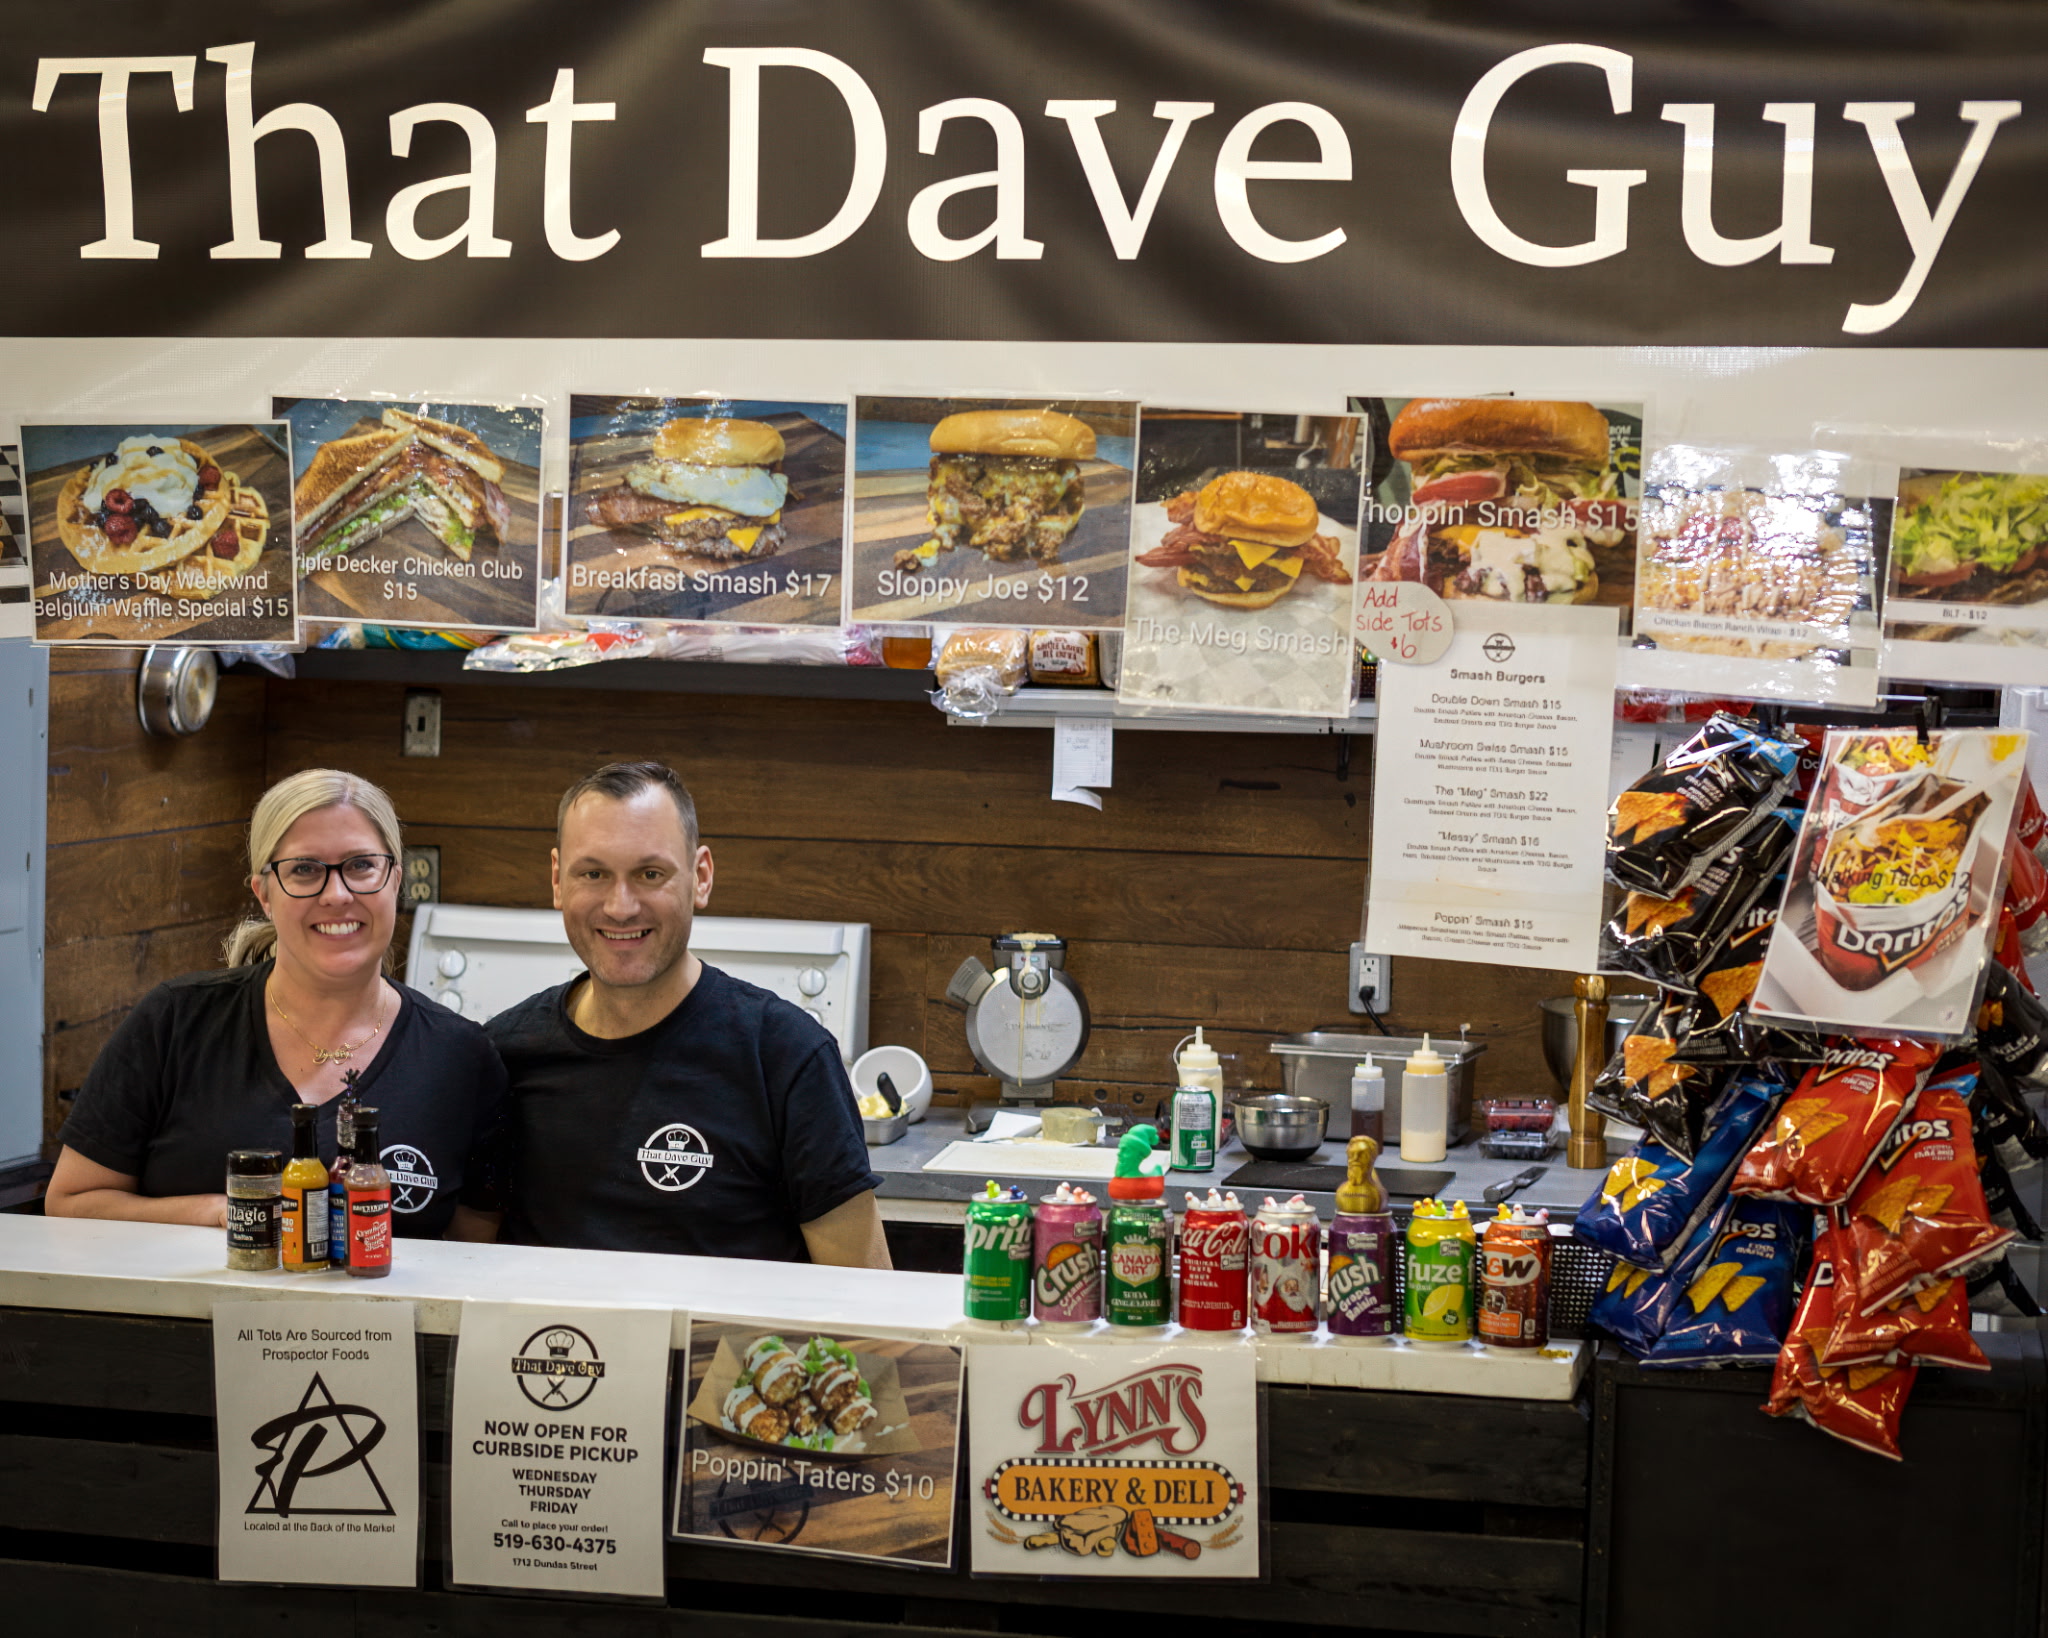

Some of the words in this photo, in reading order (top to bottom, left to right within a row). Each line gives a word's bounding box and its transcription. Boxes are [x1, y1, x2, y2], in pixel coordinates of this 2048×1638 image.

[31, 41, 621, 262] That
[701, 46, 1353, 264] Dave
[1450, 43, 2023, 334] Guy
[1366, 500, 1470, 533] hoppin'
[1477, 501, 1577, 529] Smash
[1587, 501, 1640, 532] $15
[296, 553, 332, 575] riple
[336, 554, 399, 574] Decker
[403, 557, 476, 578] Chicken
[481, 560, 523, 580] Club
[49, 571, 130, 590] Mother's
[136, 571, 172, 595] Day
[176, 571, 269, 591] Weekwnd
[383, 580, 418, 601] $15
[572, 563, 686, 592] Breakfast
[692, 569, 777, 595] Smash
[785, 570, 833, 598] $17
[877, 569, 970, 604] Sloppy
[976, 573, 1029, 600] Joe
[1037, 572, 1089, 604] $12
[35, 598, 107, 621] Belgium
[112, 597, 173, 617] Waffle
[178, 598, 246, 621] Special
[252, 596, 289, 619] $15
[1363, 586, 1399, 609] Add
[1400, 610, 1443, 633] Tots
[1132, 617, 1181, 645] The
[1189, 621, 1249, 655] Meg
[1256, 625, 1349, 656] Smash
[1450, 669, 1492, 681] Smash
[1496, 670, 1546, 685] Burgers
[1431, 693, 1468, 704] Double
[1420, 738, 1473, 751] Mushroom
[641, 1150, 662, 1160] That
[664, 1152, 688, 1163] Dave
[1111, 1253, 1161, 1265] CANADA
[1122, 1265, 1148, 1275] DRY
[1407, 1253, 1462, 1284] fuze
[1037, 1242, 1099, 1305] Crush
[238, 1329, 253, 1341] All
[257, 1329, 282, 1341] Tots
[286, 1329, 308, 1341] Are
[311, 1329, 361, 1342] Sourced
[365, 1329, 392, 1342] from
[262, 1348, 328, 1363] Prospector
[332, 1349, 370, 1361] Foods
[514, 1358, 542, 1373] That
[546, 1359, 574, 1375] Dave
[1019, 1364, 1207, 1456] LYNN'S
[484, 1420, 529, 1436] NOW
[534, 1423, 584, 1440] OPEN
[590, 1427, 627, 1442] FOR
[472, 1440, 564, 1459] CURBSIDE
[570, 1445, 639, 1463] PICKUP
[512, 1468, 597, 1484] WEDNESDAY
[692, 1449, 786, 1485] Poppin'
[794, 1460, 876, 1493] Taters
[884, 1468, 935, 1500] $10
[518, 1484, 591, 1499] THURSDAY
[1014, 1476, 1119, 1503] BAKERY
[1126, 1477, 1147, 1505] &
[1154, 1479, 1215, 1505] DELI
[530, 1501, 578, 1515] FRIDAY
[244, 1521, 280, 1532] Located
[282, 1522, 291, 1532] at
[294, 1521, 308, 1532] the
[310, 1522, 333, 1532] Back
[335, 1522, 345, 1532] of
[347, 1522, 361, 1532] the
[364, 1522, 395, 1533] Market
[501, 1519, 518, 1528] Call
[520, 1519, 530, 1529] to
[532, 1520, 556, 1531] place
[559, 1523, 578, 1533] your
[493, 1532, 617, 1554] 519-630-4375
[534, 1558, 568, 1570] Dundas
[570, 1560, 598, 1571] Street
